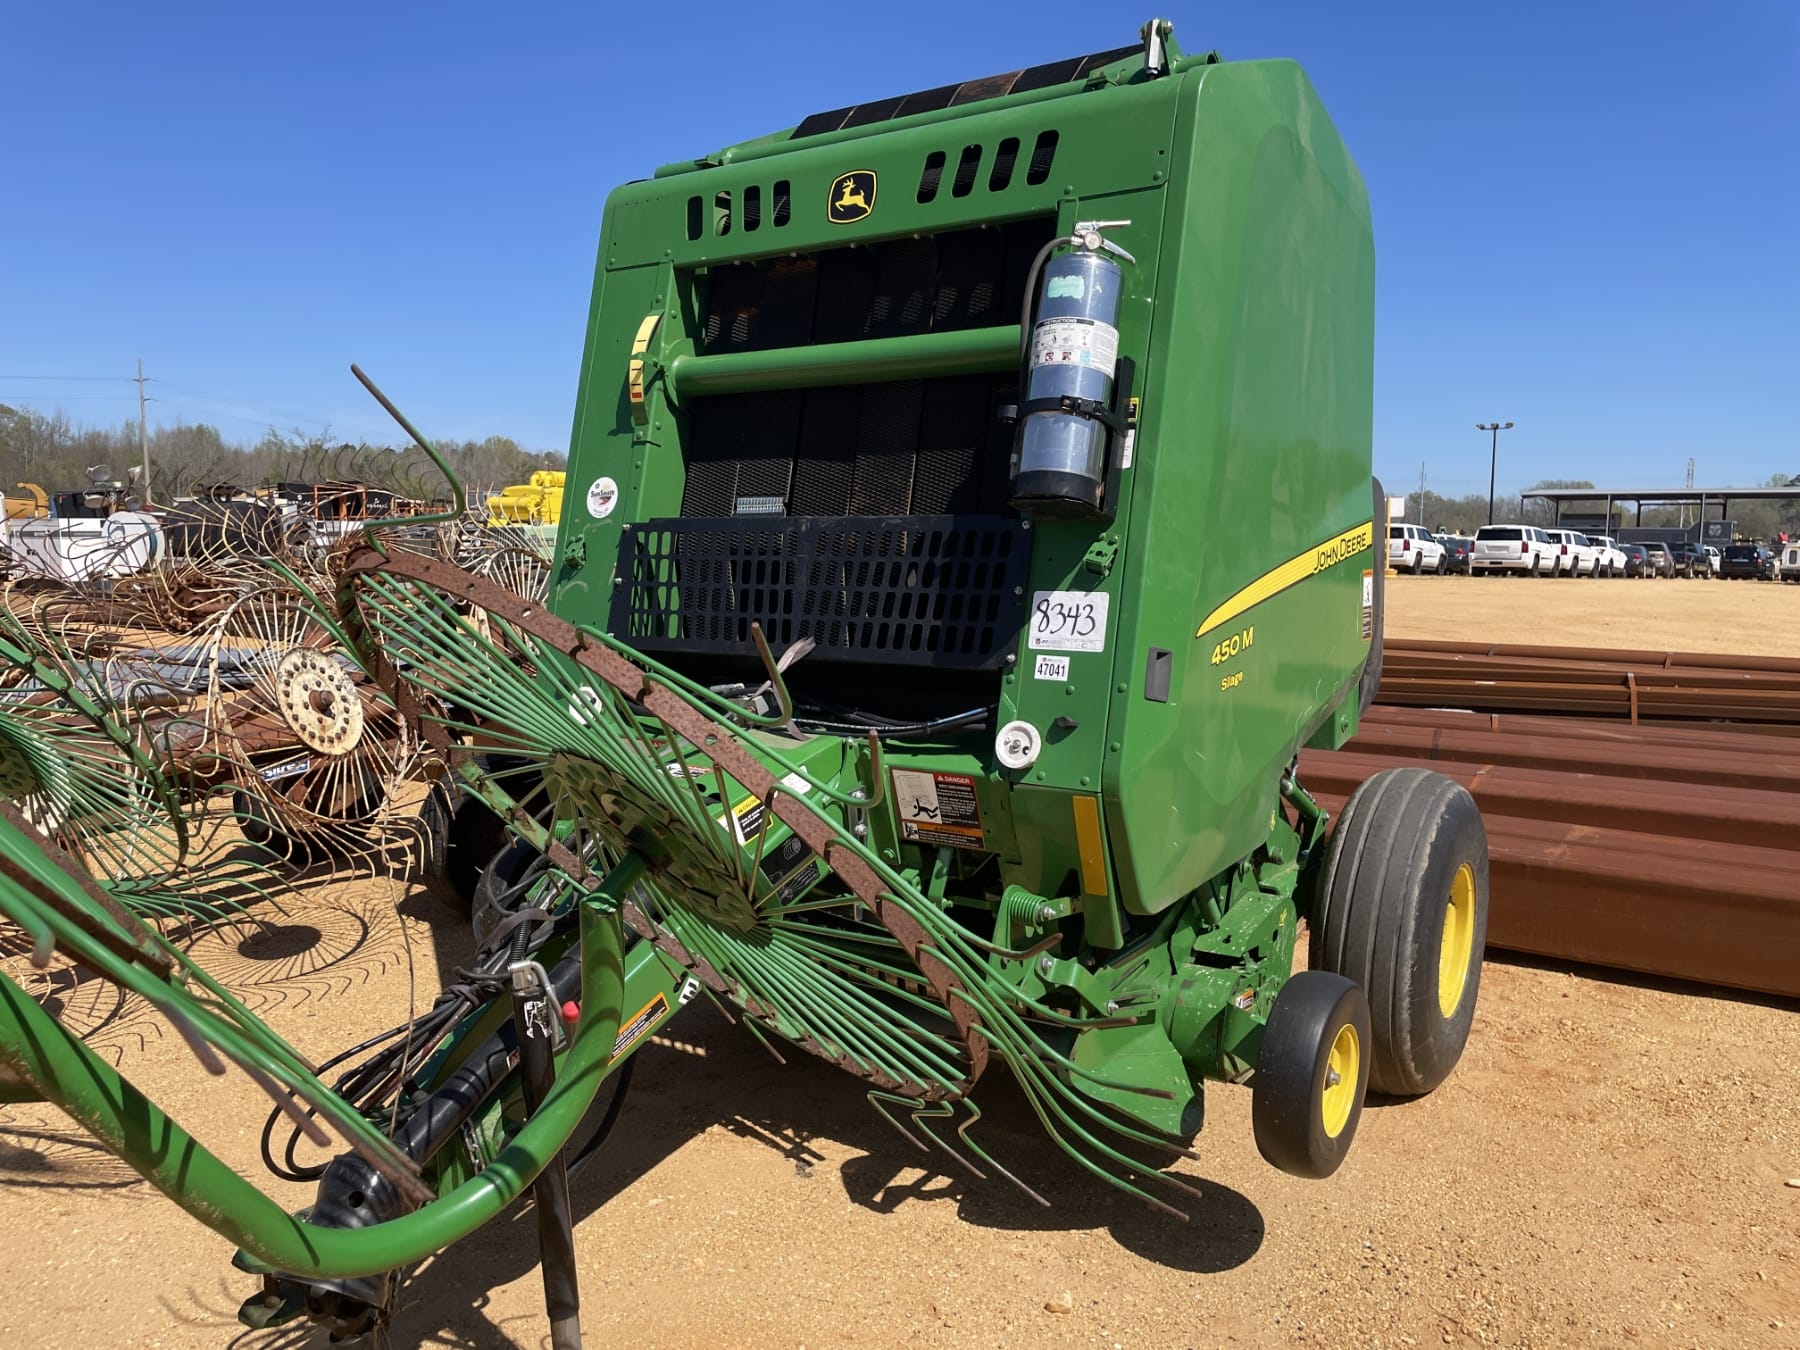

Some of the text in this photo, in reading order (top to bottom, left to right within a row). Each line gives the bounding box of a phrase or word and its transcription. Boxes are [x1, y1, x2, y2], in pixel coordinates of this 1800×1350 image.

[1314, 532, 1367, 571] JOHN DEERE
[1036, 599, 1096, 636] 8343
[1211, 625, 1254, 665] 450 M
[1037, 663, 1066, 677] 47041
[1221, 671, 1244, 691] Silage
[944, 776, 970, 784] DANGER
